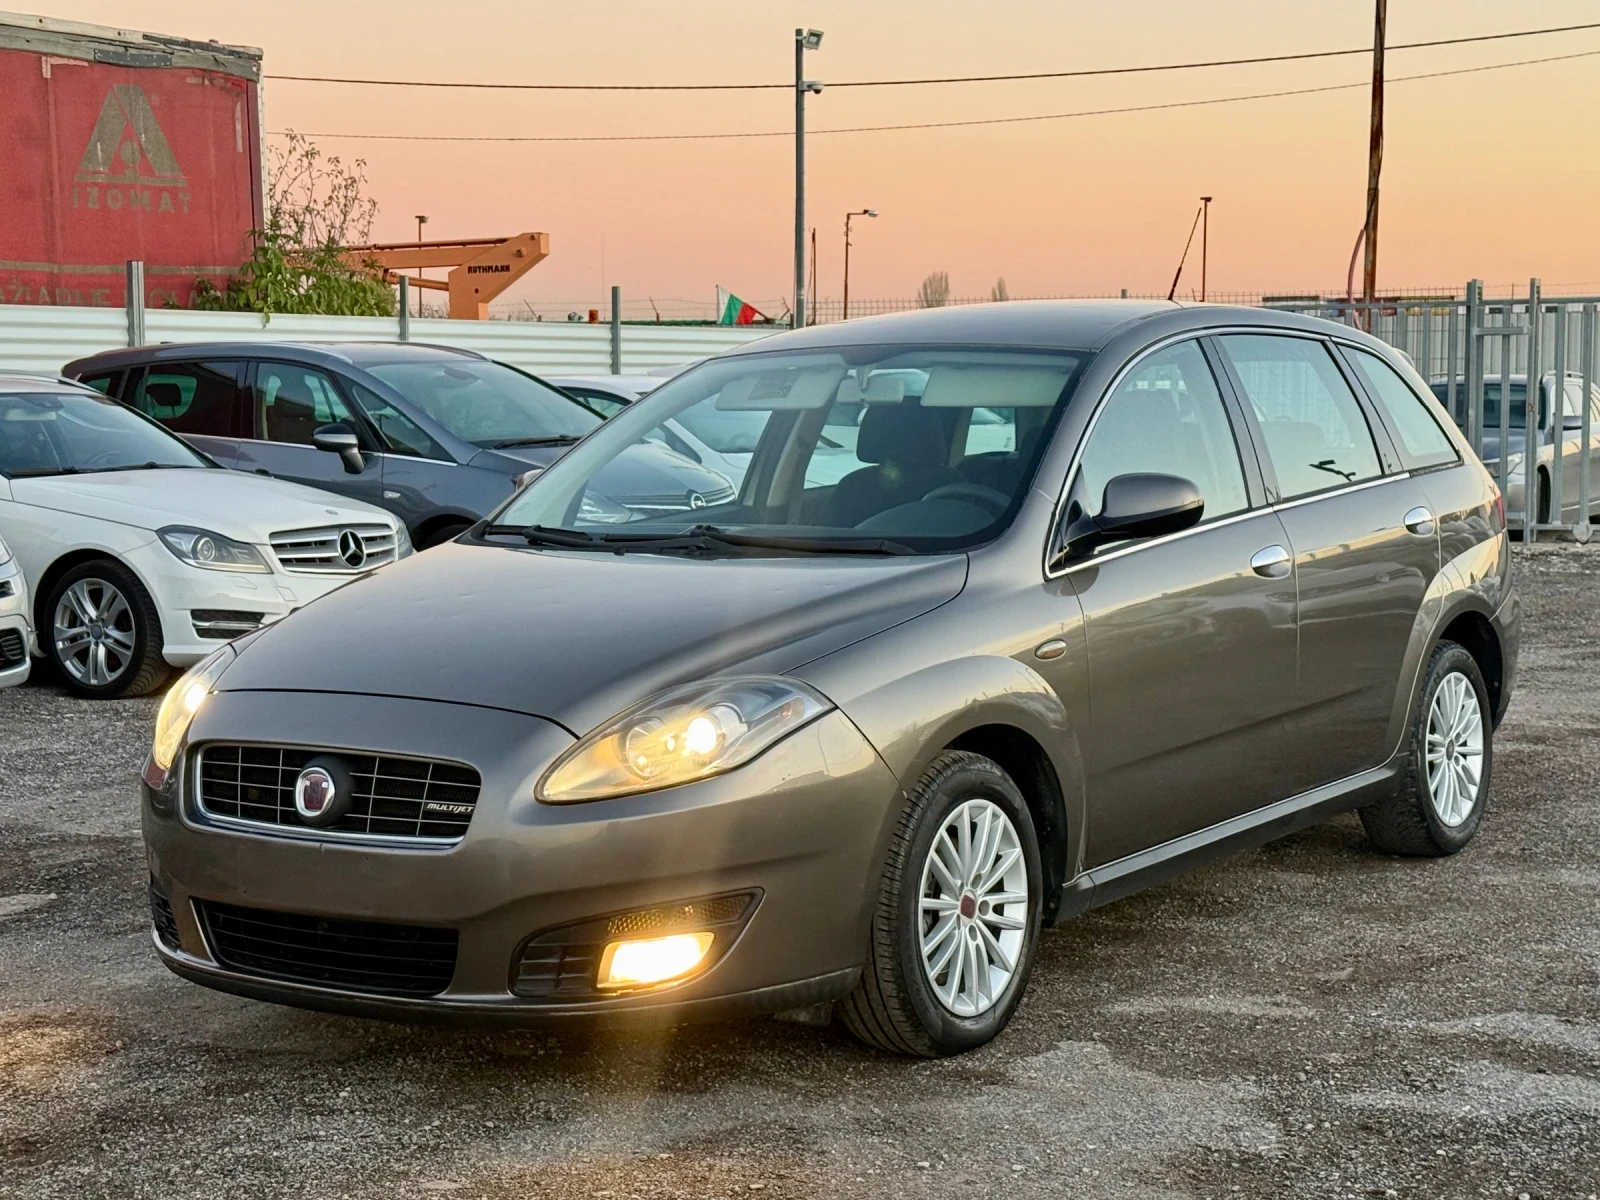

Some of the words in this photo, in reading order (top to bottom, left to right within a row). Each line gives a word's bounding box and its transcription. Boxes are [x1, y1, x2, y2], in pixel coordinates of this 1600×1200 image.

[72, 186, 190, 214] IZOMAT
[467, 264, 510, 274] RUTHMANN
[427, 803, 474, 813] MULTIJET
